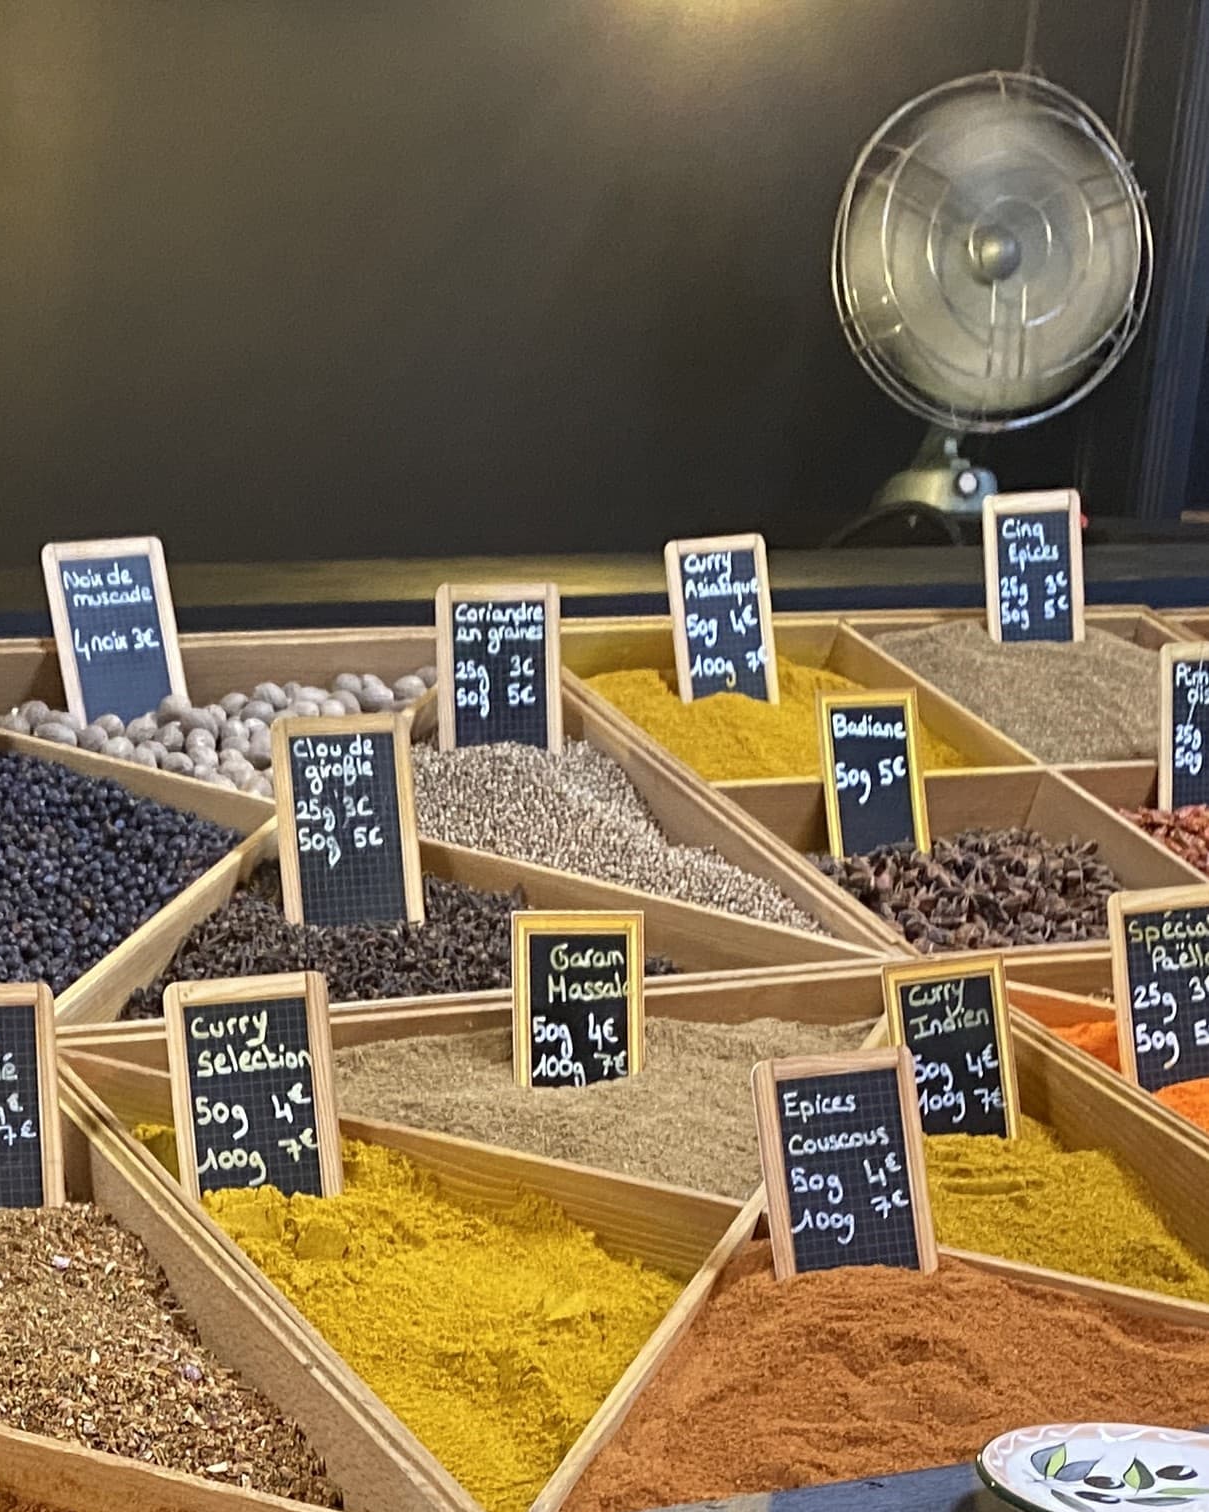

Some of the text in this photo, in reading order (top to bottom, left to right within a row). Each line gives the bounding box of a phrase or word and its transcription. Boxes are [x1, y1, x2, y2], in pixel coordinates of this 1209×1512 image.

[63, 562, 132, 590] Noix de
[684, 551, 732, 578] Curry
[73, 585, 153, 607] muscade
[1001, 576, 1028, 606] 25g
[455, 601, 544, 622] Coriandre
[686, 604, 757, 647] 50g 4€
[1001, 601, 1029, 630] 50g
[74, 628, 91, 661] 4
[456, 621, 542, 655] en graines
[456, 660, 490, 692] 25g
[691, 653, 736, 688] 100g
[457, 687, 490, 718] 50g
[832, 713, 906, 739] Badiane
[293, 734, 374, 759] Clou de
[305, 754, 373, 795] girofle
[835, 761, 871, 805] 50g
[296, 799, 336, 832] 25g
[298, 826, 341, 869] 50g
[550, 943, 624, 971] Garam
[909, 979, 964, 1013] Curry
[1134, 982, 1177, 1025] 25g
[191, 1009, 268, 1048] Curry
[533, 1012, 619, 1059] 50g 4€
[910, 1005, 989, 1040] Indien
[1136, 1019, 1209, 1070] 50g 5
[532, 1050, 627, 1087] 100g 7€
[913, 1043, 998, 1092] 50g 4€
[195, 1082, 311, 1141] 50g 4€
[783, 1090, 856, 1123] Epices
[919, 1086, 1006, 1124] 100g 7€
[198, 1127, 318, 1187] 100g 7€
[788, 1126, 890, 1156] Couscous
[791, 1152, 902, 1205] 50g 4€
[791, 1189, 909, 1245] 100g 7€
